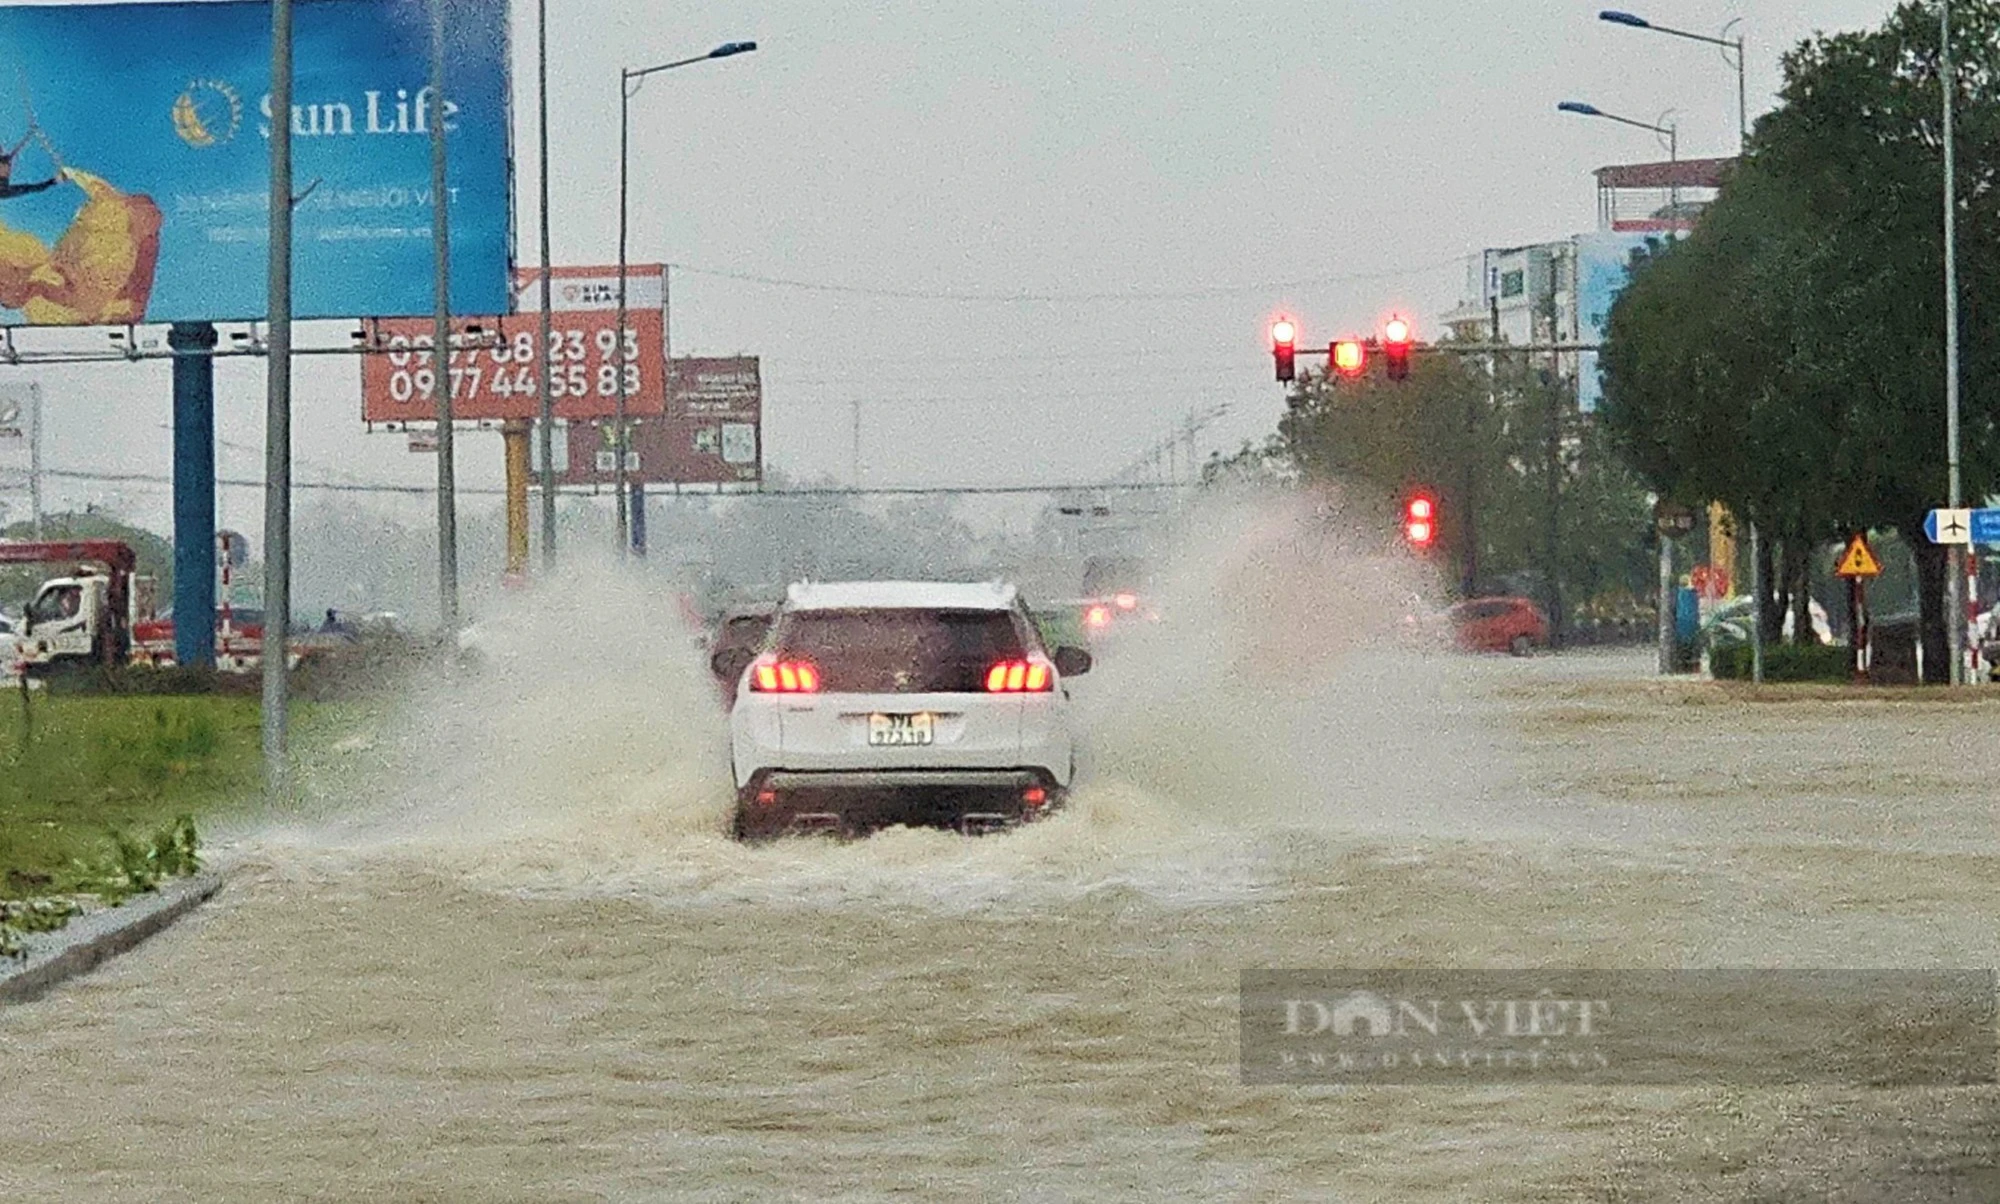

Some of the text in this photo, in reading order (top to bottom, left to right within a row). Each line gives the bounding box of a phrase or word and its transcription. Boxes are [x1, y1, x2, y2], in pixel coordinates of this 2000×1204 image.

[364, 85, 459, 134] Life
[547, 329, 586, 361] 23
[490, 365, 537, 397] 44
[548, 364, 588, 397] 55
